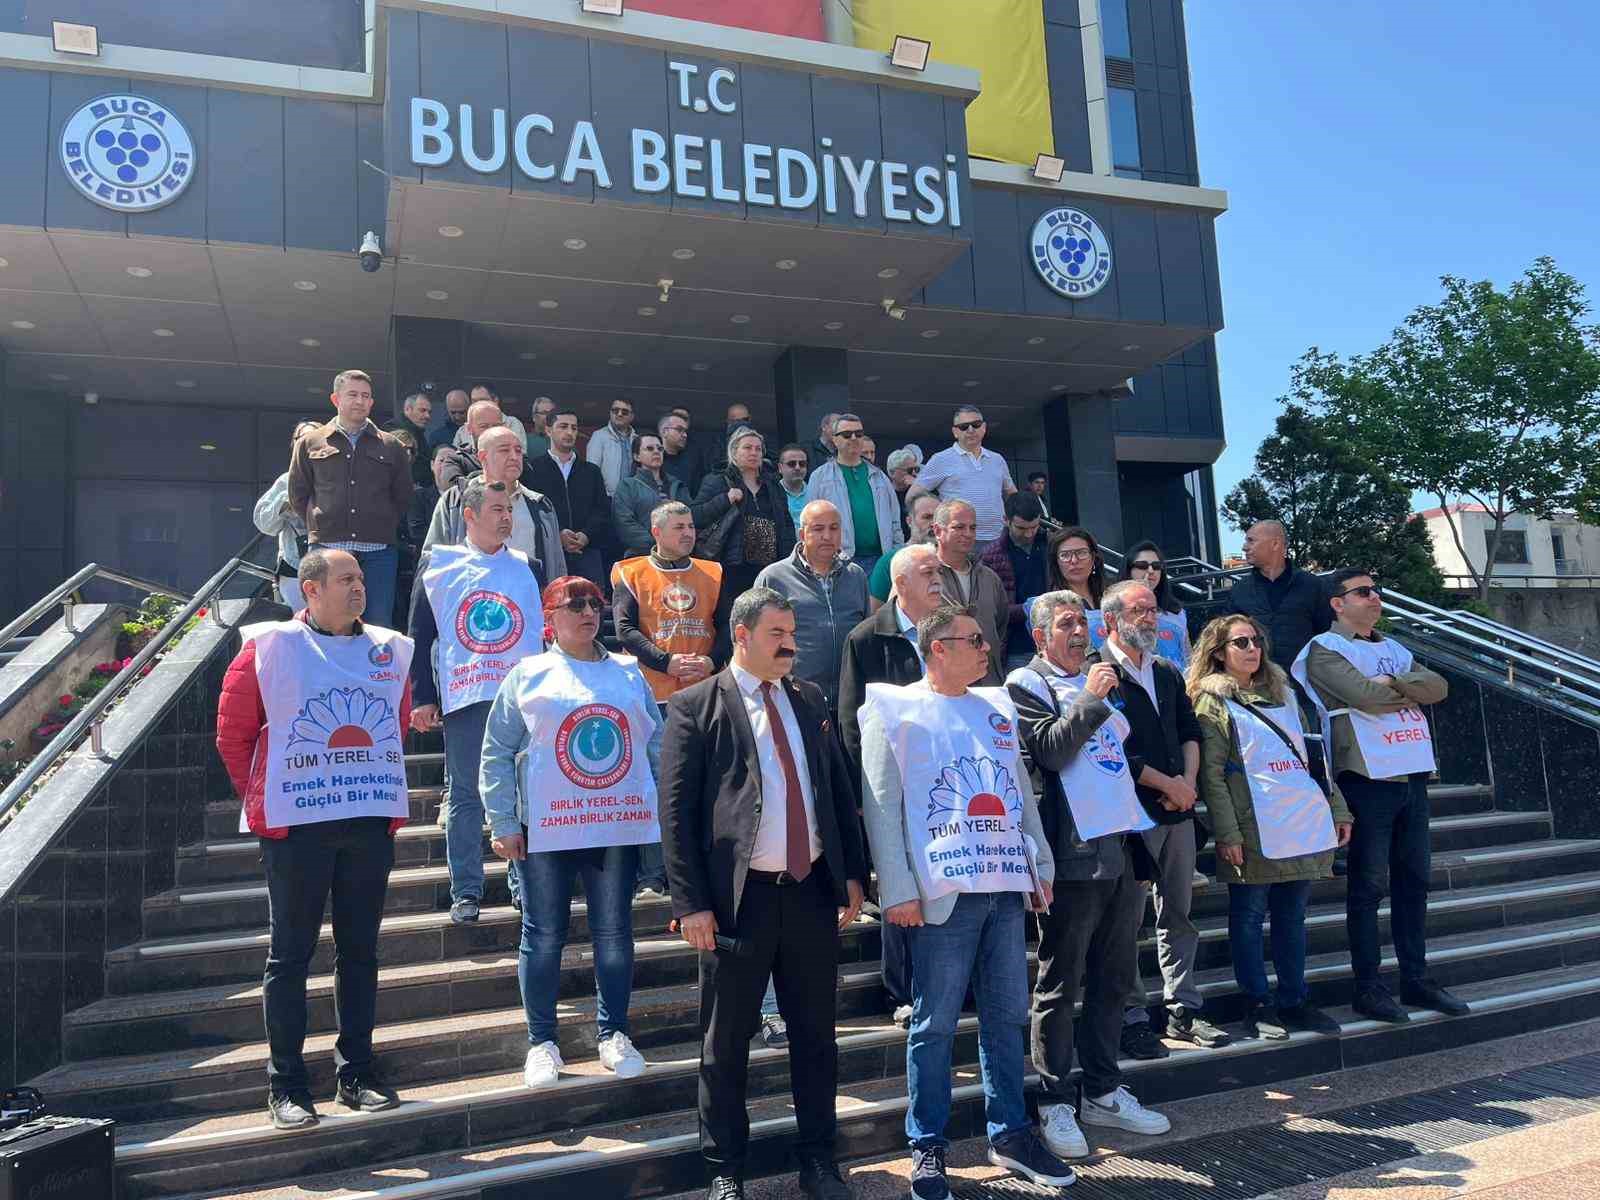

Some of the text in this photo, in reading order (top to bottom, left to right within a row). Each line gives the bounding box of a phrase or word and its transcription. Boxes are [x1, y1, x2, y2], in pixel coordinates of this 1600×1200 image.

[669, 61, 737, 113] T.C
[90, 98, 167, 128] BUCA
[410, 96, 961, 227] BUCA BELEDİYESİ
[1046, 210, 1093, 233] BUCA
[1383, 728, 1431, 745] YEREL
[285, 753, 319, 770] TÜM
[323, 750, 375, 765] YEREL
[282, 777, 326, 793] Emek
[295, 792, 342, 809] Güçlü
[347, 790, 369, 802] Bir
[587, 795, 643, 808] YEREL-SEN
[540, 814, 578, 828] ZAMAN
[928, 822, 961, 840] TÜM
[964, 819, 1006, 833] YEREL
[929, 846, 972, 863] Emek
[943, 861, 985, 878] Güçlü
[987, 861, 998, 873] Bir
